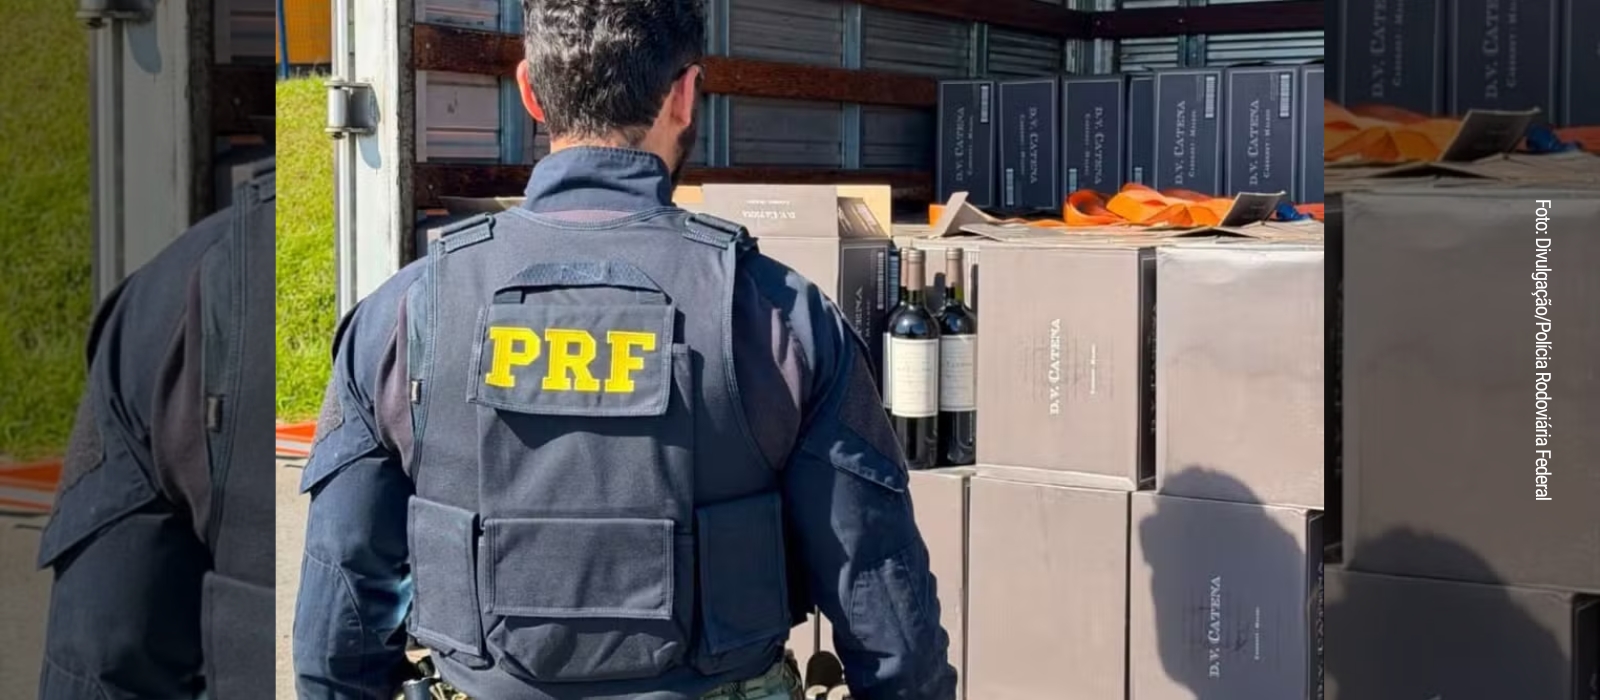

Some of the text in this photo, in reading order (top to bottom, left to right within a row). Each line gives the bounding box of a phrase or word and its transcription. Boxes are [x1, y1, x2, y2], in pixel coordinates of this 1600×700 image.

[1370, 0, 1386, 54] CATE
[1483, 0, 1499, 54] CATE
[1173, 100, 1186, 156] CATENA
[1247, 100, 1259, 157] CATENA
[854, 285, 864, 334] TENA
[484, 326, 656, 393] PRF
[1048, 318, 1061, 415] D.V. CATENA
[1207, 574, 1222, 678] D.V. CATENA
